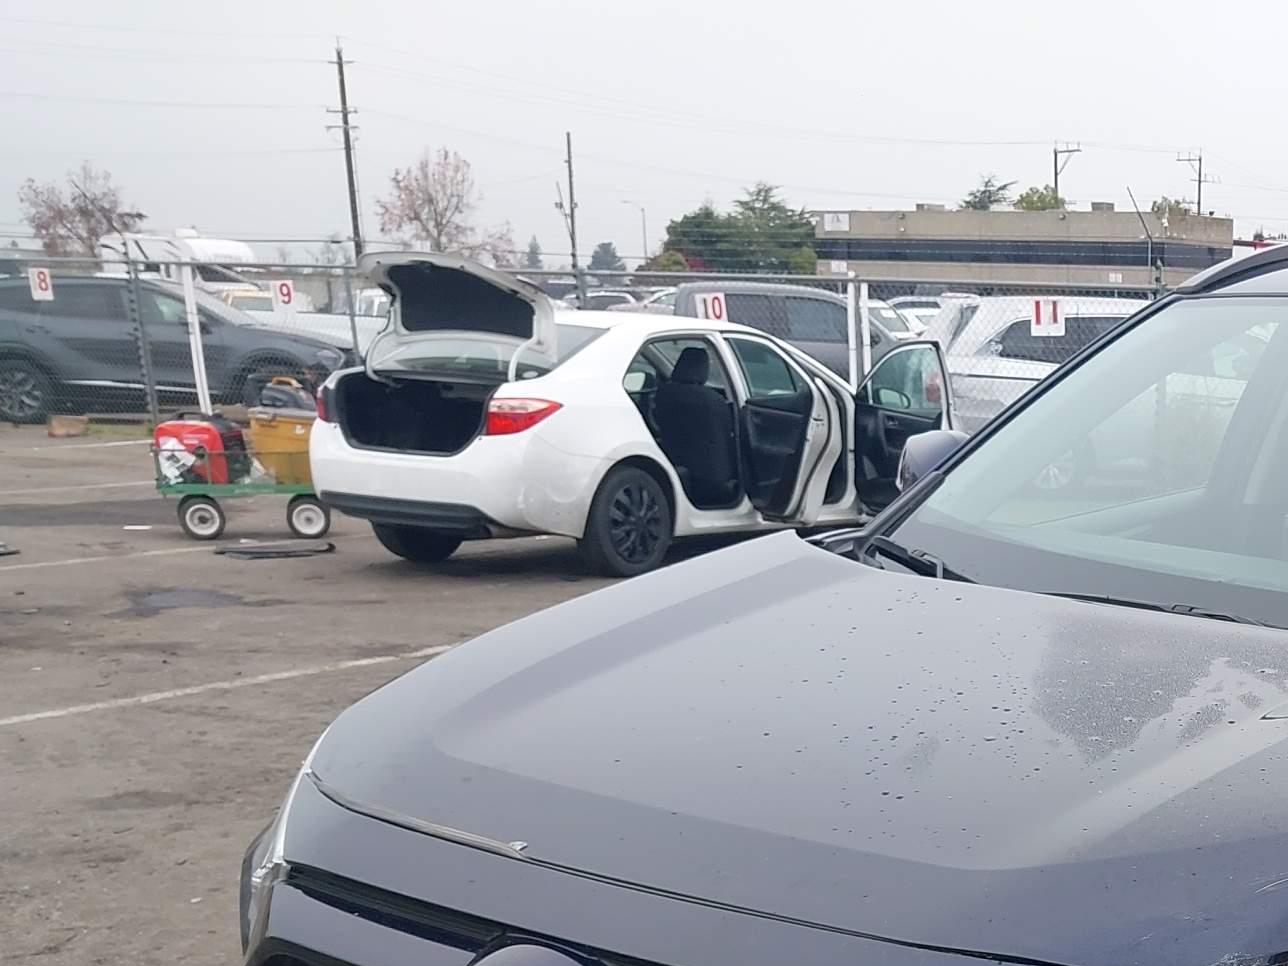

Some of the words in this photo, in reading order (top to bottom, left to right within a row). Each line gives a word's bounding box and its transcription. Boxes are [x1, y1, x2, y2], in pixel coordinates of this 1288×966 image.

[37, 269, 49, 291] 8
[278, 282, 292, 304] 9
[702, 293, 723, 318] 10
[1035, 300, 1059, 325] 11
